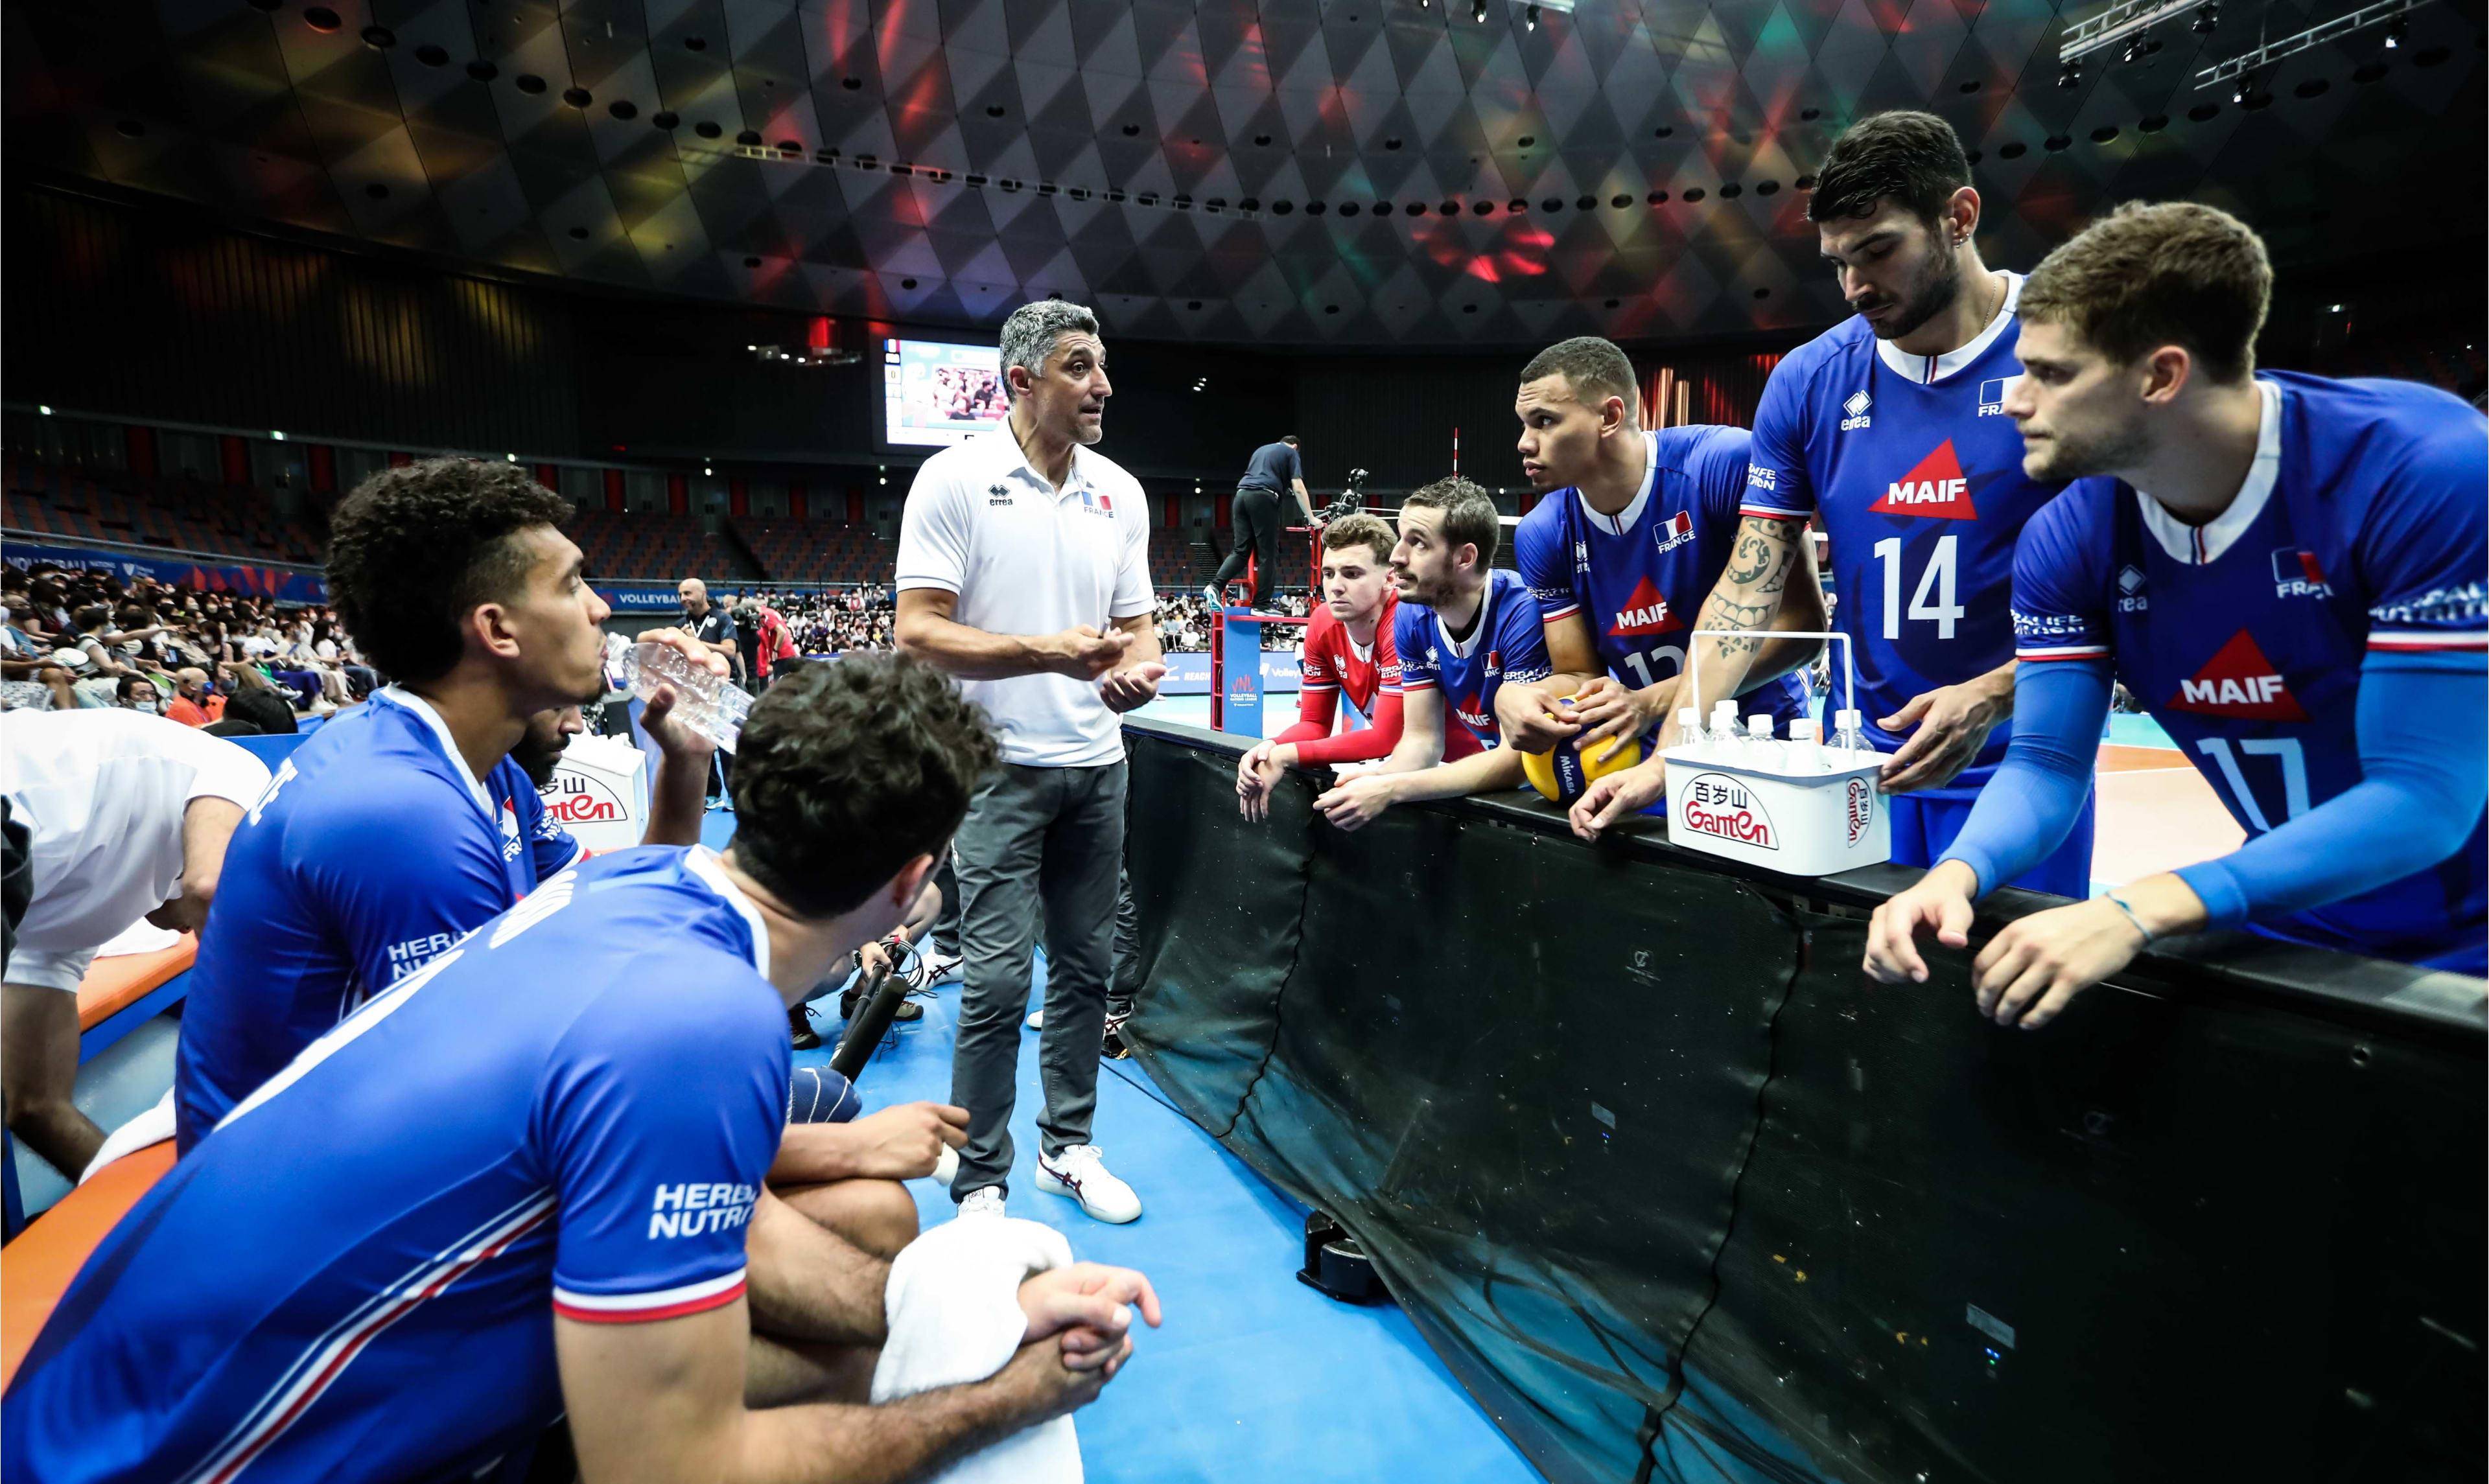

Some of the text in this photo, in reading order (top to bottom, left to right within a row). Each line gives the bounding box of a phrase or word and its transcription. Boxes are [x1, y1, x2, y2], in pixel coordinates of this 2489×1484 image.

[1887, 478, 1967, 505] MAIF
[1083, 506, 1114, 518] FRANCE
[1657, 529, 1696, 554] FRANCE
[1874, 535, 1965, 640] 14
[1615, 601, 1668, 629] MAIF
[2180, 675, 2283, 704] MAIF
[1456, 708, 1491, 726] MAIF
[1694, 782, 1747, 809] 百岁山
[2195, 737, 2311, 833] 17
